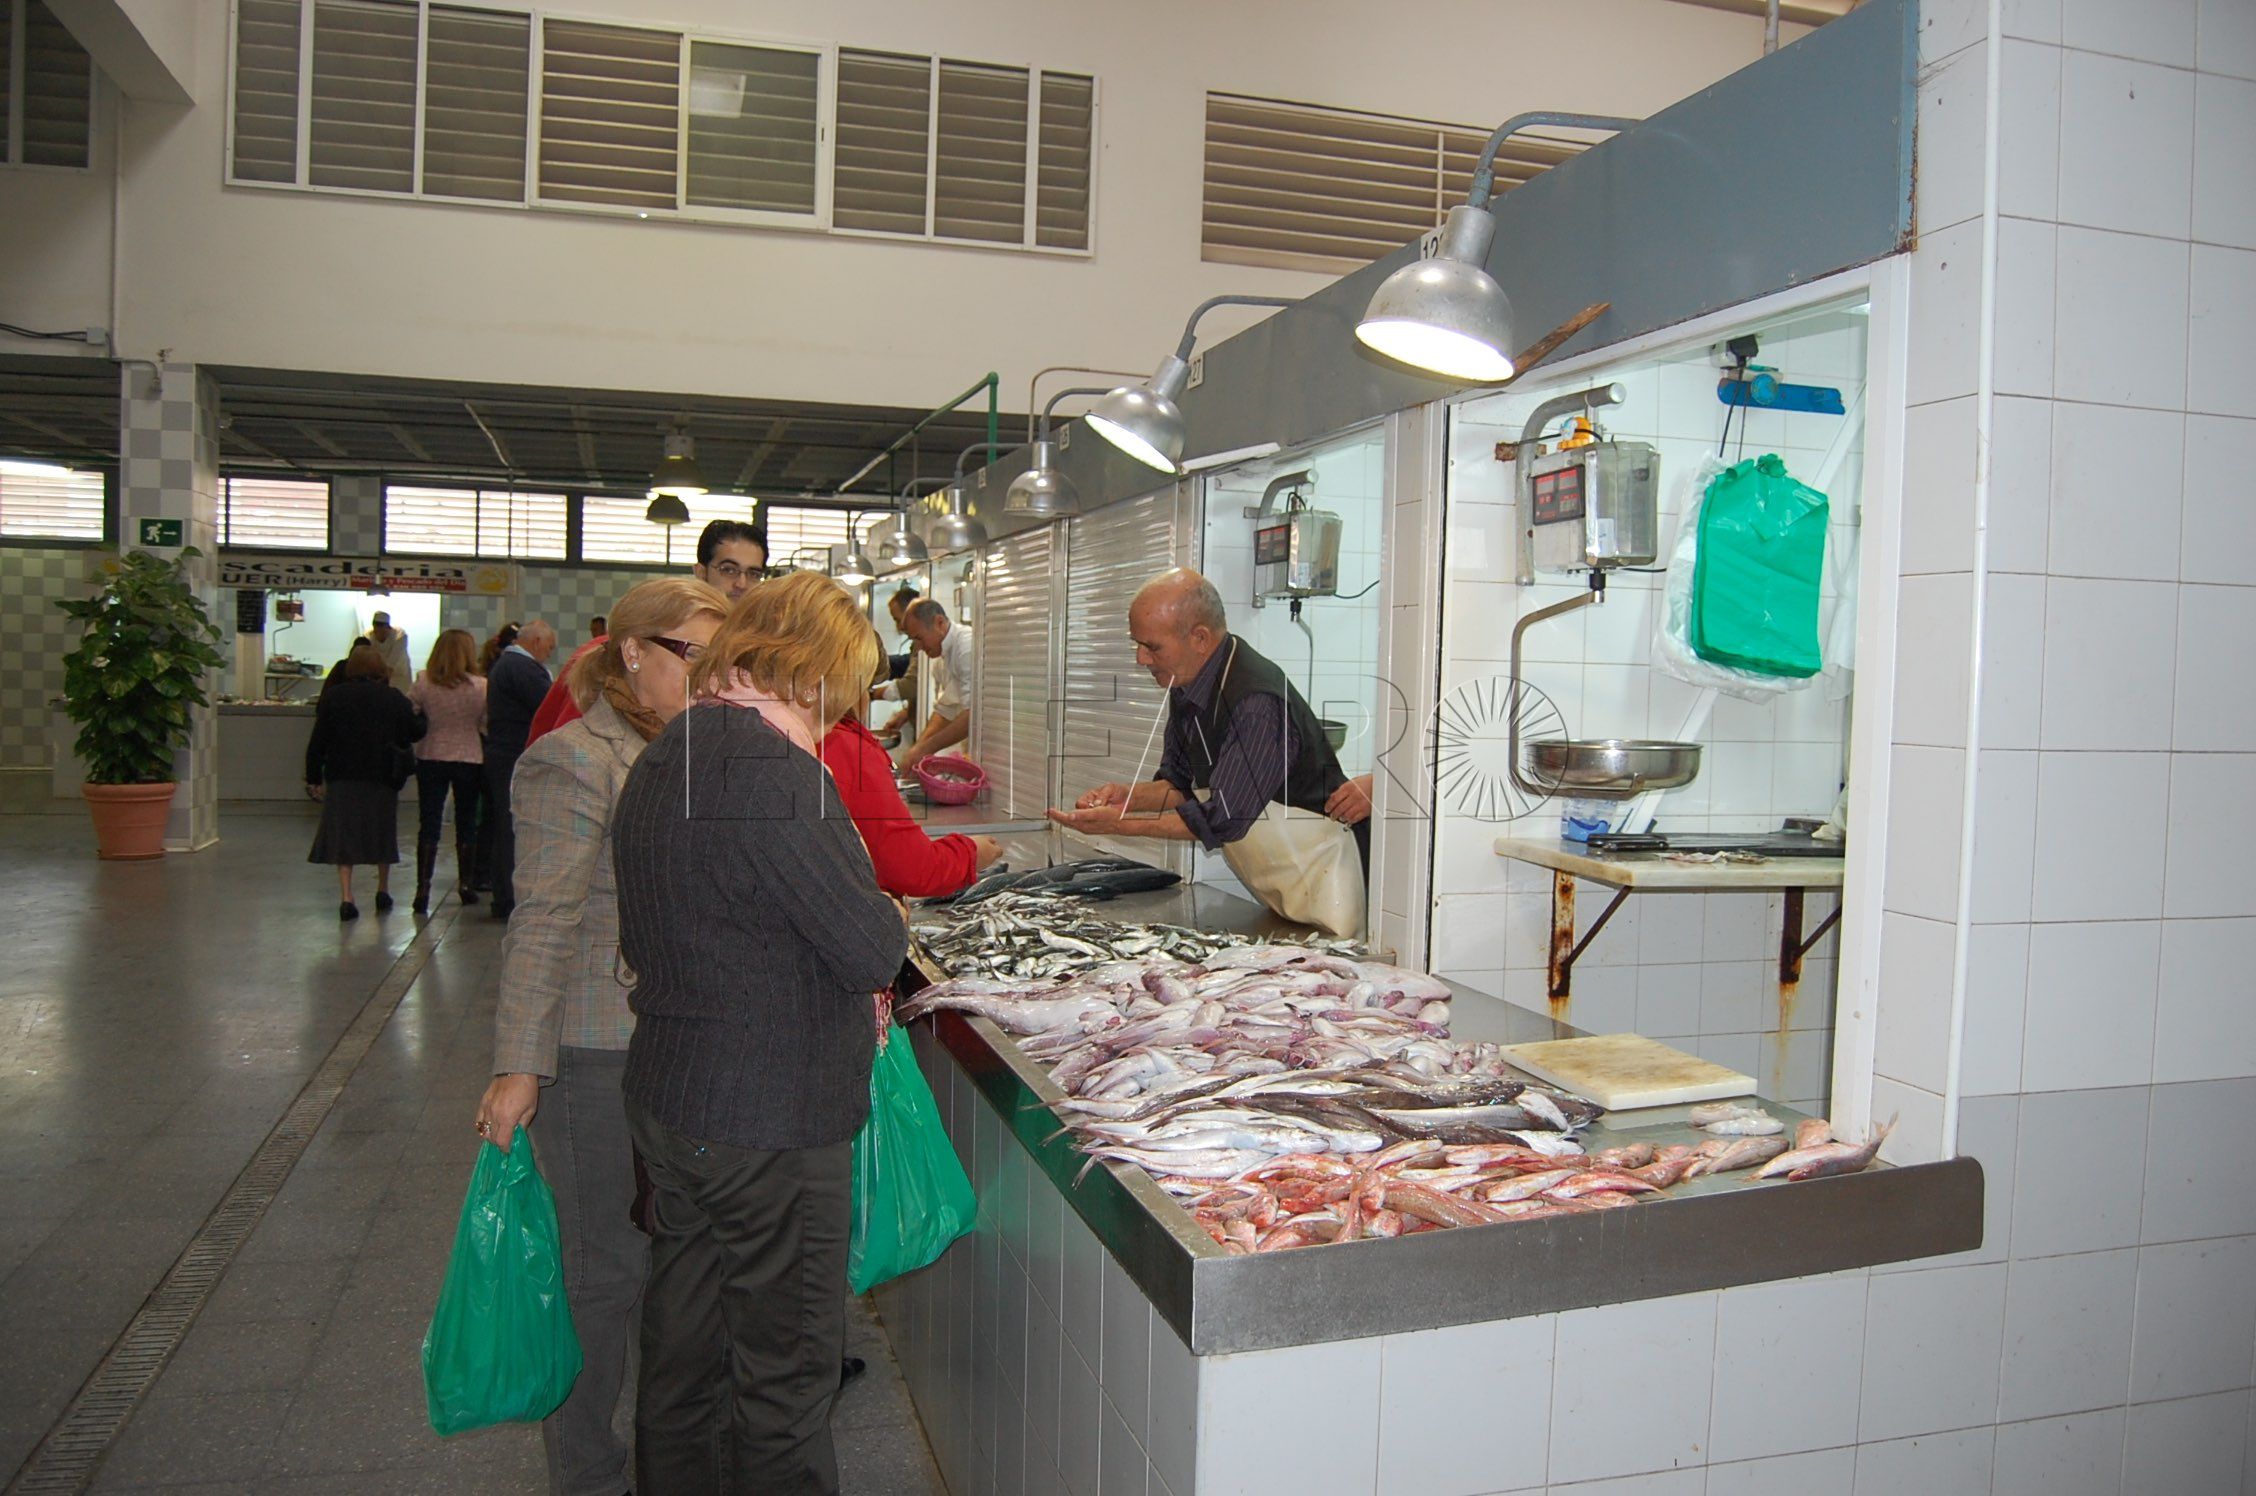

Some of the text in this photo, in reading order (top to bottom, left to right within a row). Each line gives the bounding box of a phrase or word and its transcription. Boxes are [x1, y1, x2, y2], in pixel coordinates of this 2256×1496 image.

[1423, 232, 1443, 259] 12
[218, 561, 463, 577] scaderia
[222, 573, 347, 587] UER (Harry)
